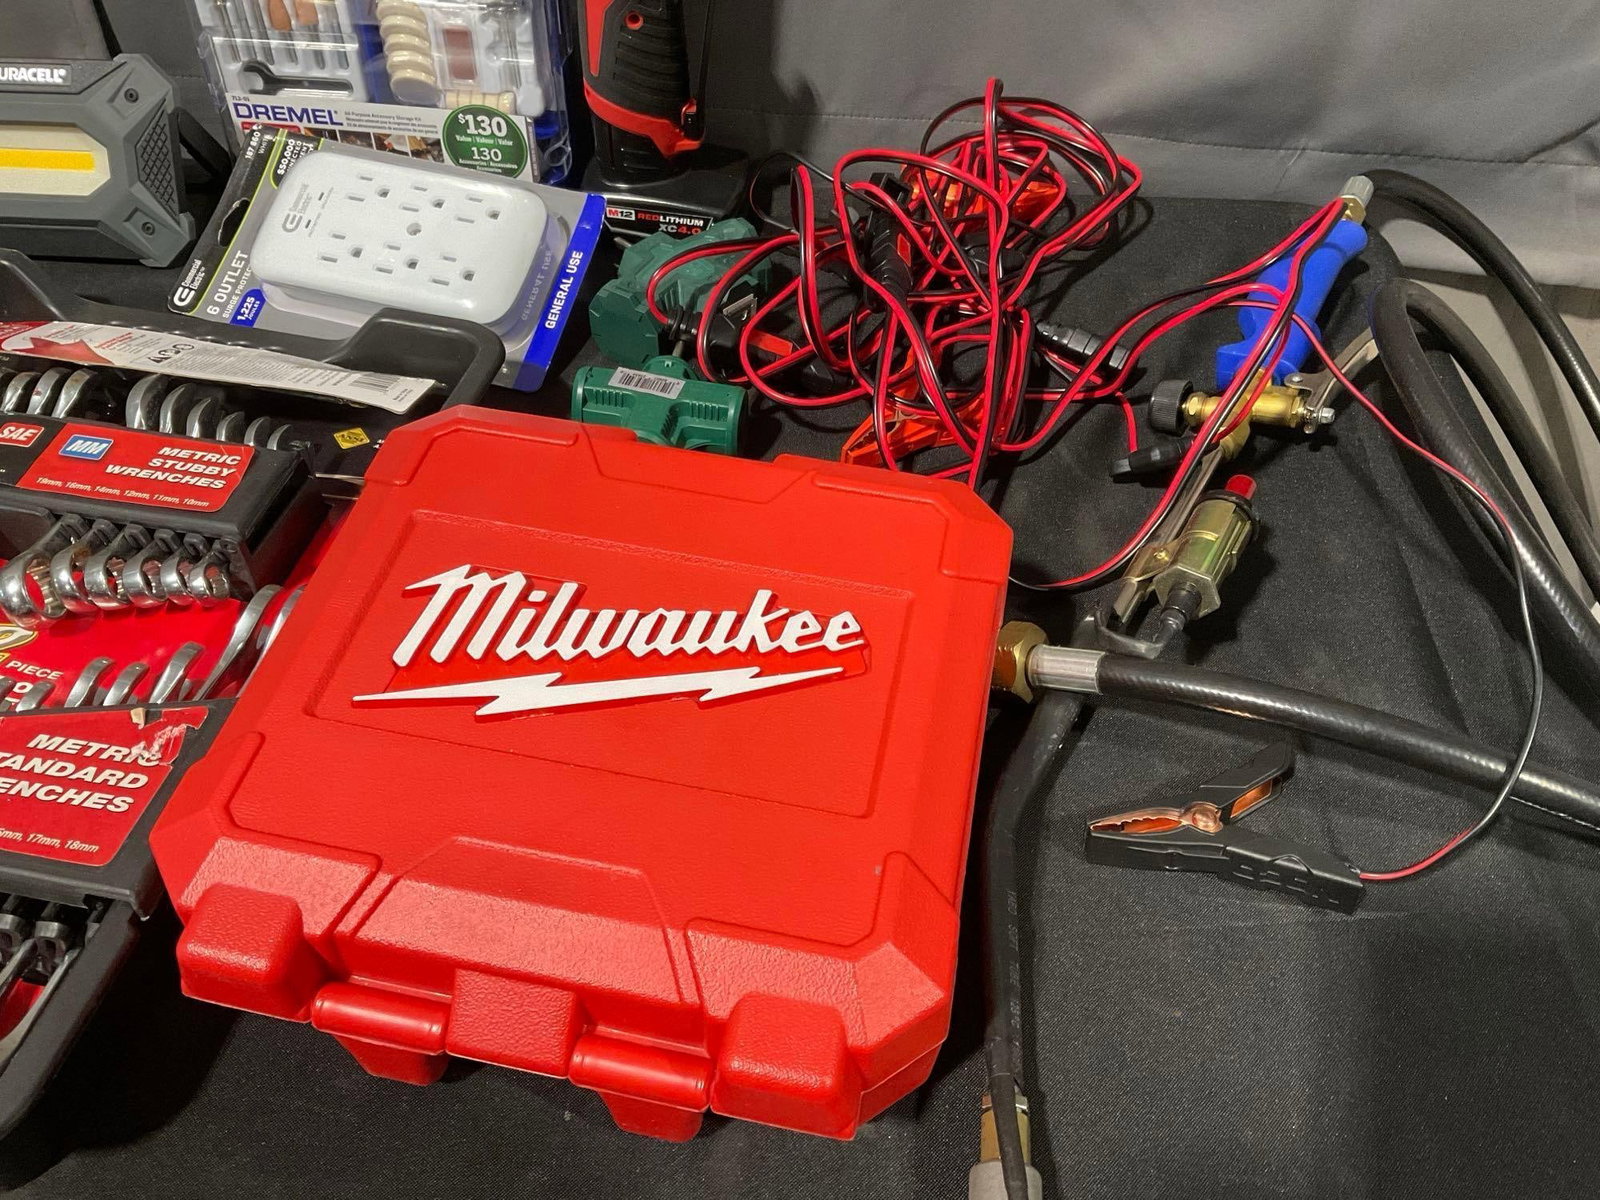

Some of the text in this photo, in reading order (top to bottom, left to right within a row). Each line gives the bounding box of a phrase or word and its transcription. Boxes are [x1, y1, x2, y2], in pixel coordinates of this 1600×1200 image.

[0, 67, 63, 83] URACELL
[233, 102, 343, 126] DREMEL
[458, 113, 508, 137] $130
[245, 131, 261, 159] 187 860
[277, 139, 295, 175] $50,000
[471, 146, 502, 162] 130
[607, 208, 704, 227] M12 REDLITHIUM
[181, 259, 202, 287] Commercial
[207, 250, 248, 315] 6 OUTLET
[223, 267, 252, 319] SURGE PROTEC
[545, 251, 583, 329] GENERAL USE
[237, 296, 255, 321] 1,225
[248, 301, 260, 319] JOULES
[0, 426, 38, 441] SAE
[66, 440, 109, 455] MM
[158, 446, 242, 465] METRIC
[105, 464, 227, 489] WRENCHES
[148, 458, 236, 477] STUBBY
[392, 564, 865, 668] Milwaukee
[5, 660, 64, 680] PIECE
[0, 752, 149, 789] TANDARD
[0, 777, 135, 813] ENCHES
[27, 833, 62, 848] 17mm,
[64, 839, 100, 853] 18mm
